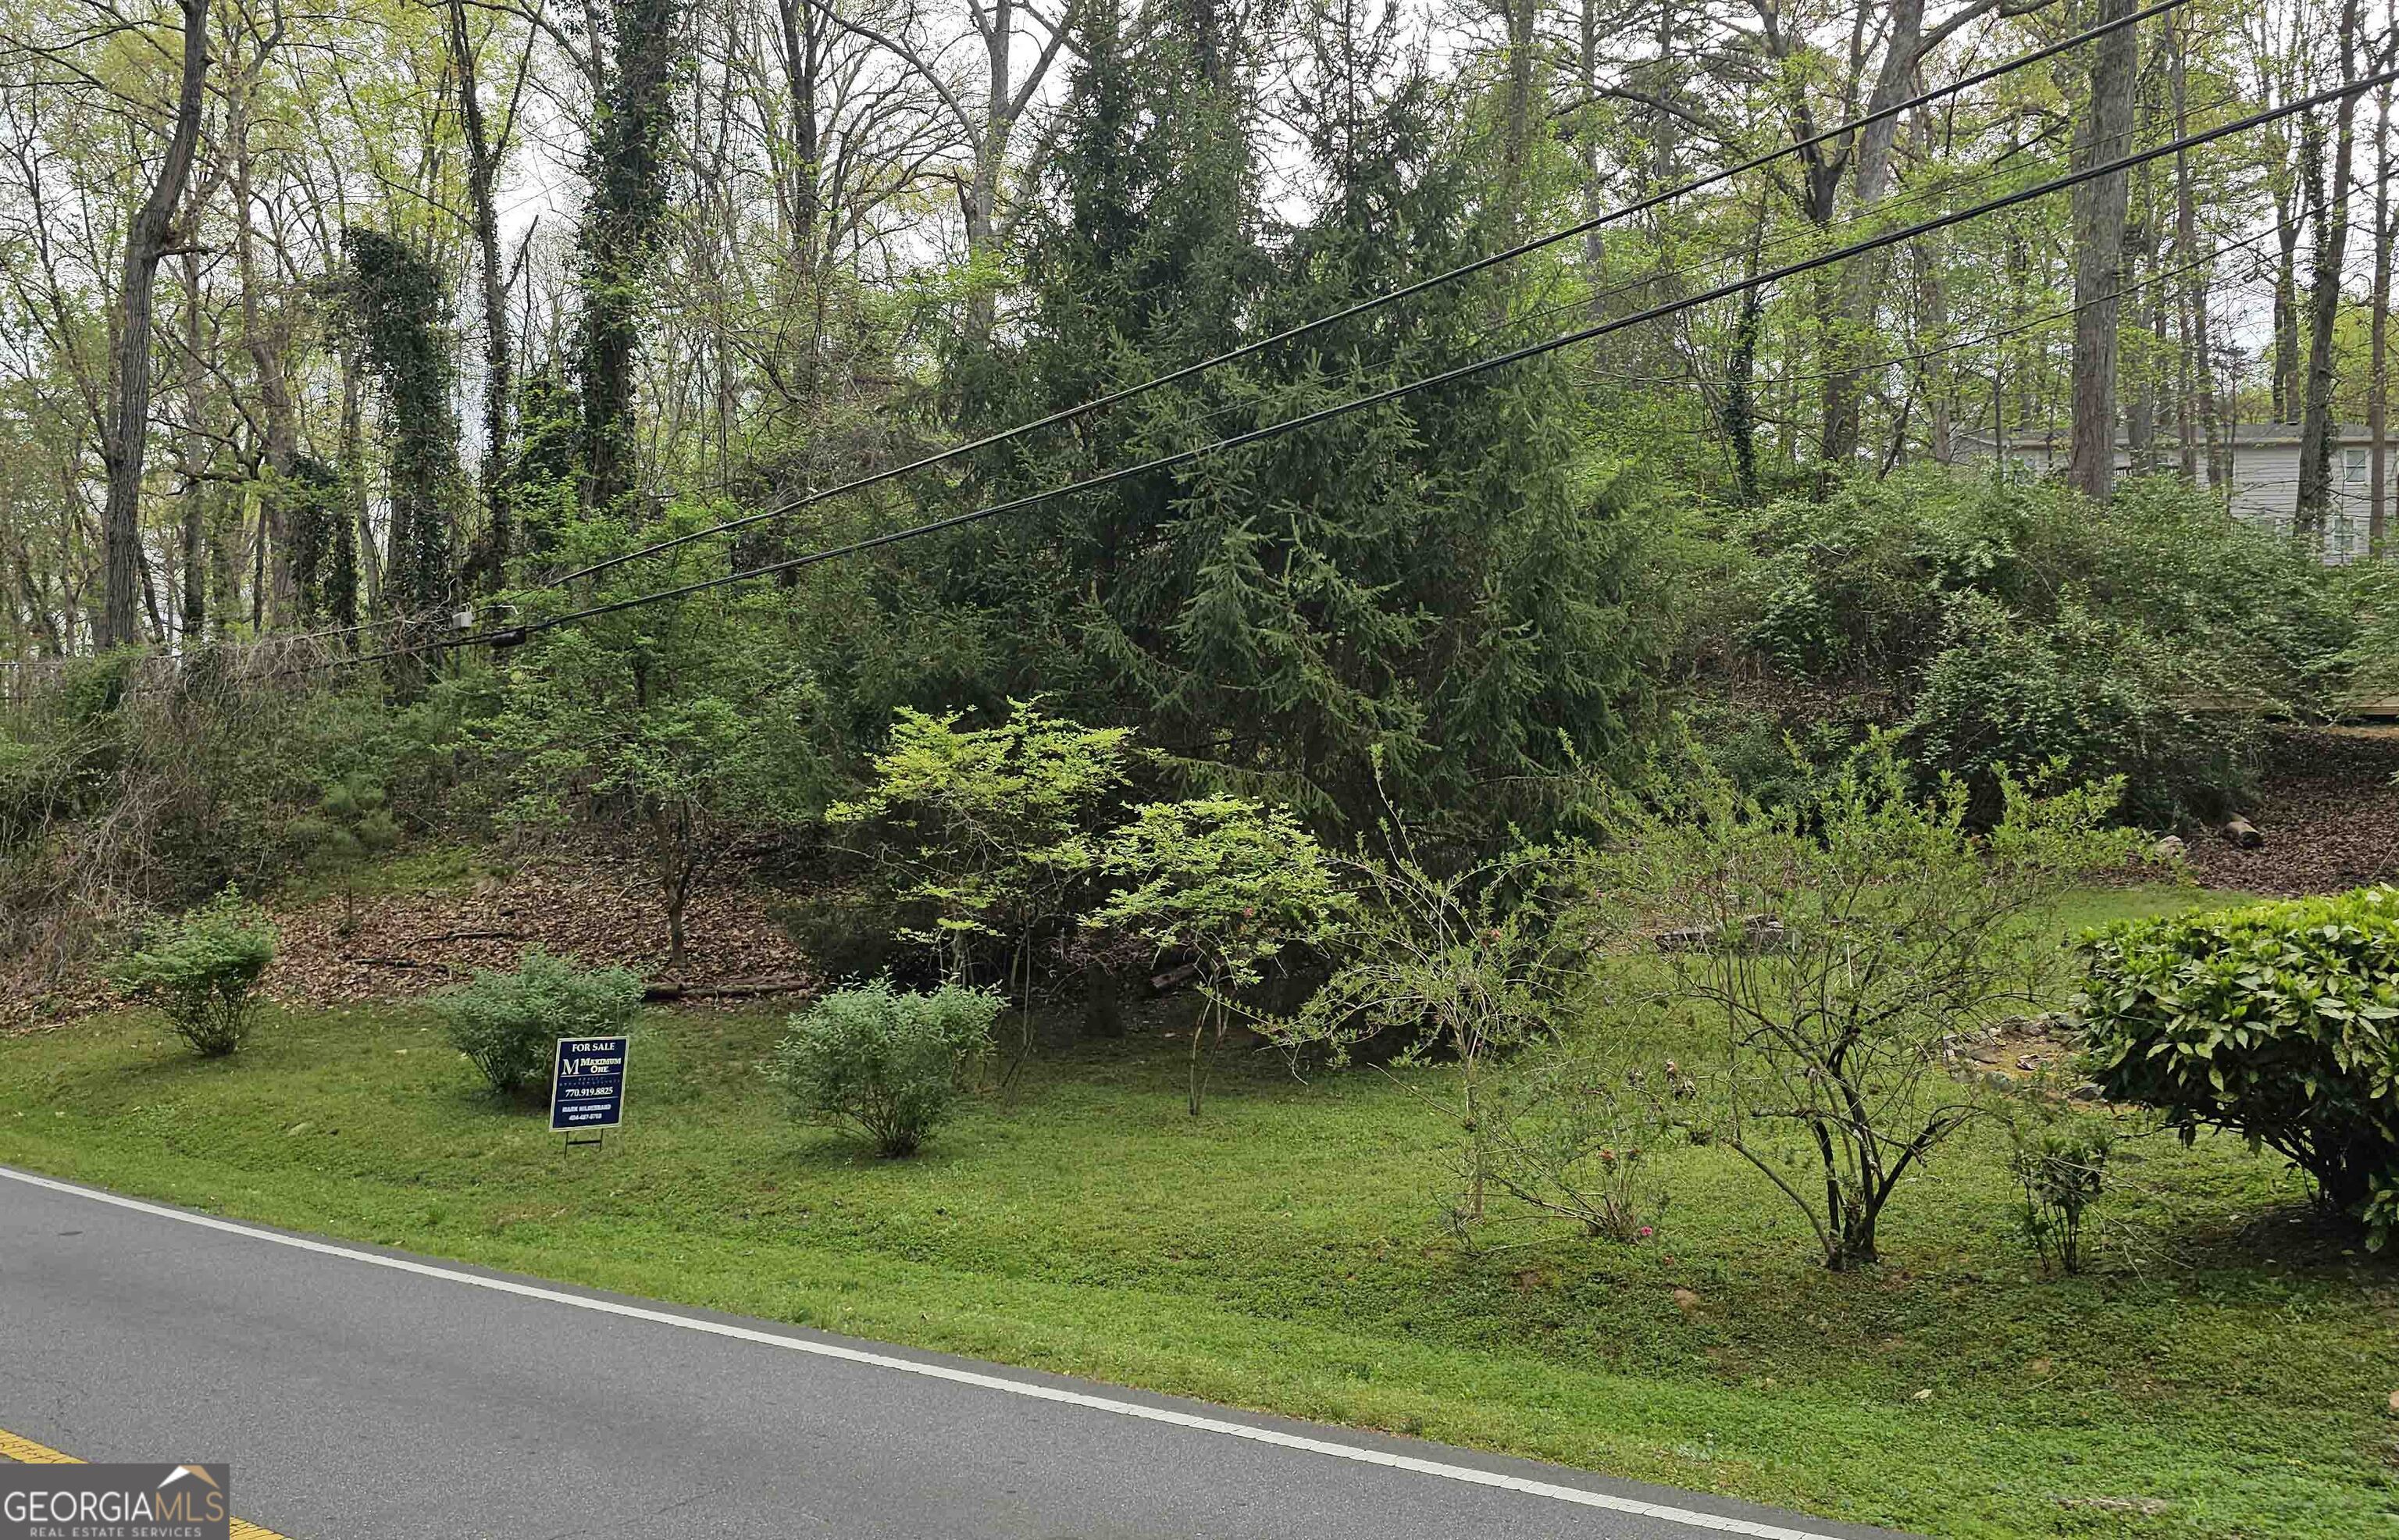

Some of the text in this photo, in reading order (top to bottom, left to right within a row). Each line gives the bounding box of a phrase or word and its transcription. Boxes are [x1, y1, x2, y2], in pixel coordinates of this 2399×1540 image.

[572, 1042, 616, 1052] FOR SALE
[561, 1058, 579, 1075] M
[590, 1065, 609, 1074] ONE
[565, 1086, 613, 1098] 770.919.8825
